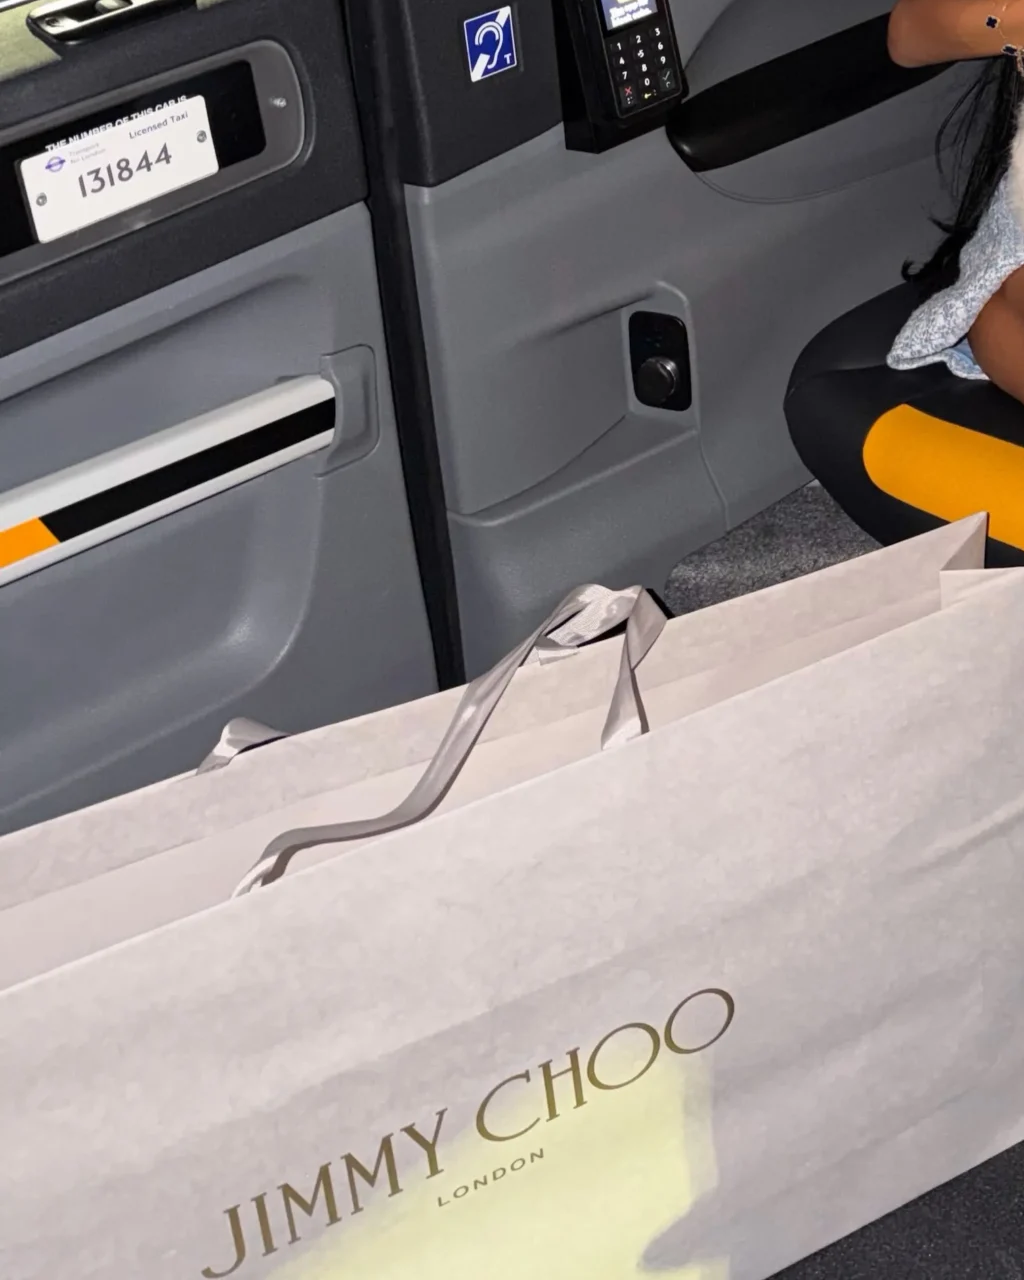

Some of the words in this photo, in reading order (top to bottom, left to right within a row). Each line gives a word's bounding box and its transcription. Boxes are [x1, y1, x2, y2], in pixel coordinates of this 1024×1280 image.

[654, 27, 660, 36] 3
[636, 35, 641, 44] 2
[616, 42, 622, 51] 1
[657, 41, 664, 50] 6
[637, 49, 644, 58] 5
[503, 52, 512, 65] T
[660, 56, 666, 65] 9
[641, 63, 647, 72] 8
[622, 71, 628, 80] 7
[644, 77, 650, 86] 0
[129, 118, 168, 140] Licensed
[169, 110, 188, 123] Taxi
[78, 142, 172, 198] 131844
[201, 1107, 449, 1279] JIMMY
[475, 988, 735, 1142] CHOO
[437, 1148, 545, 1207] LONDON
